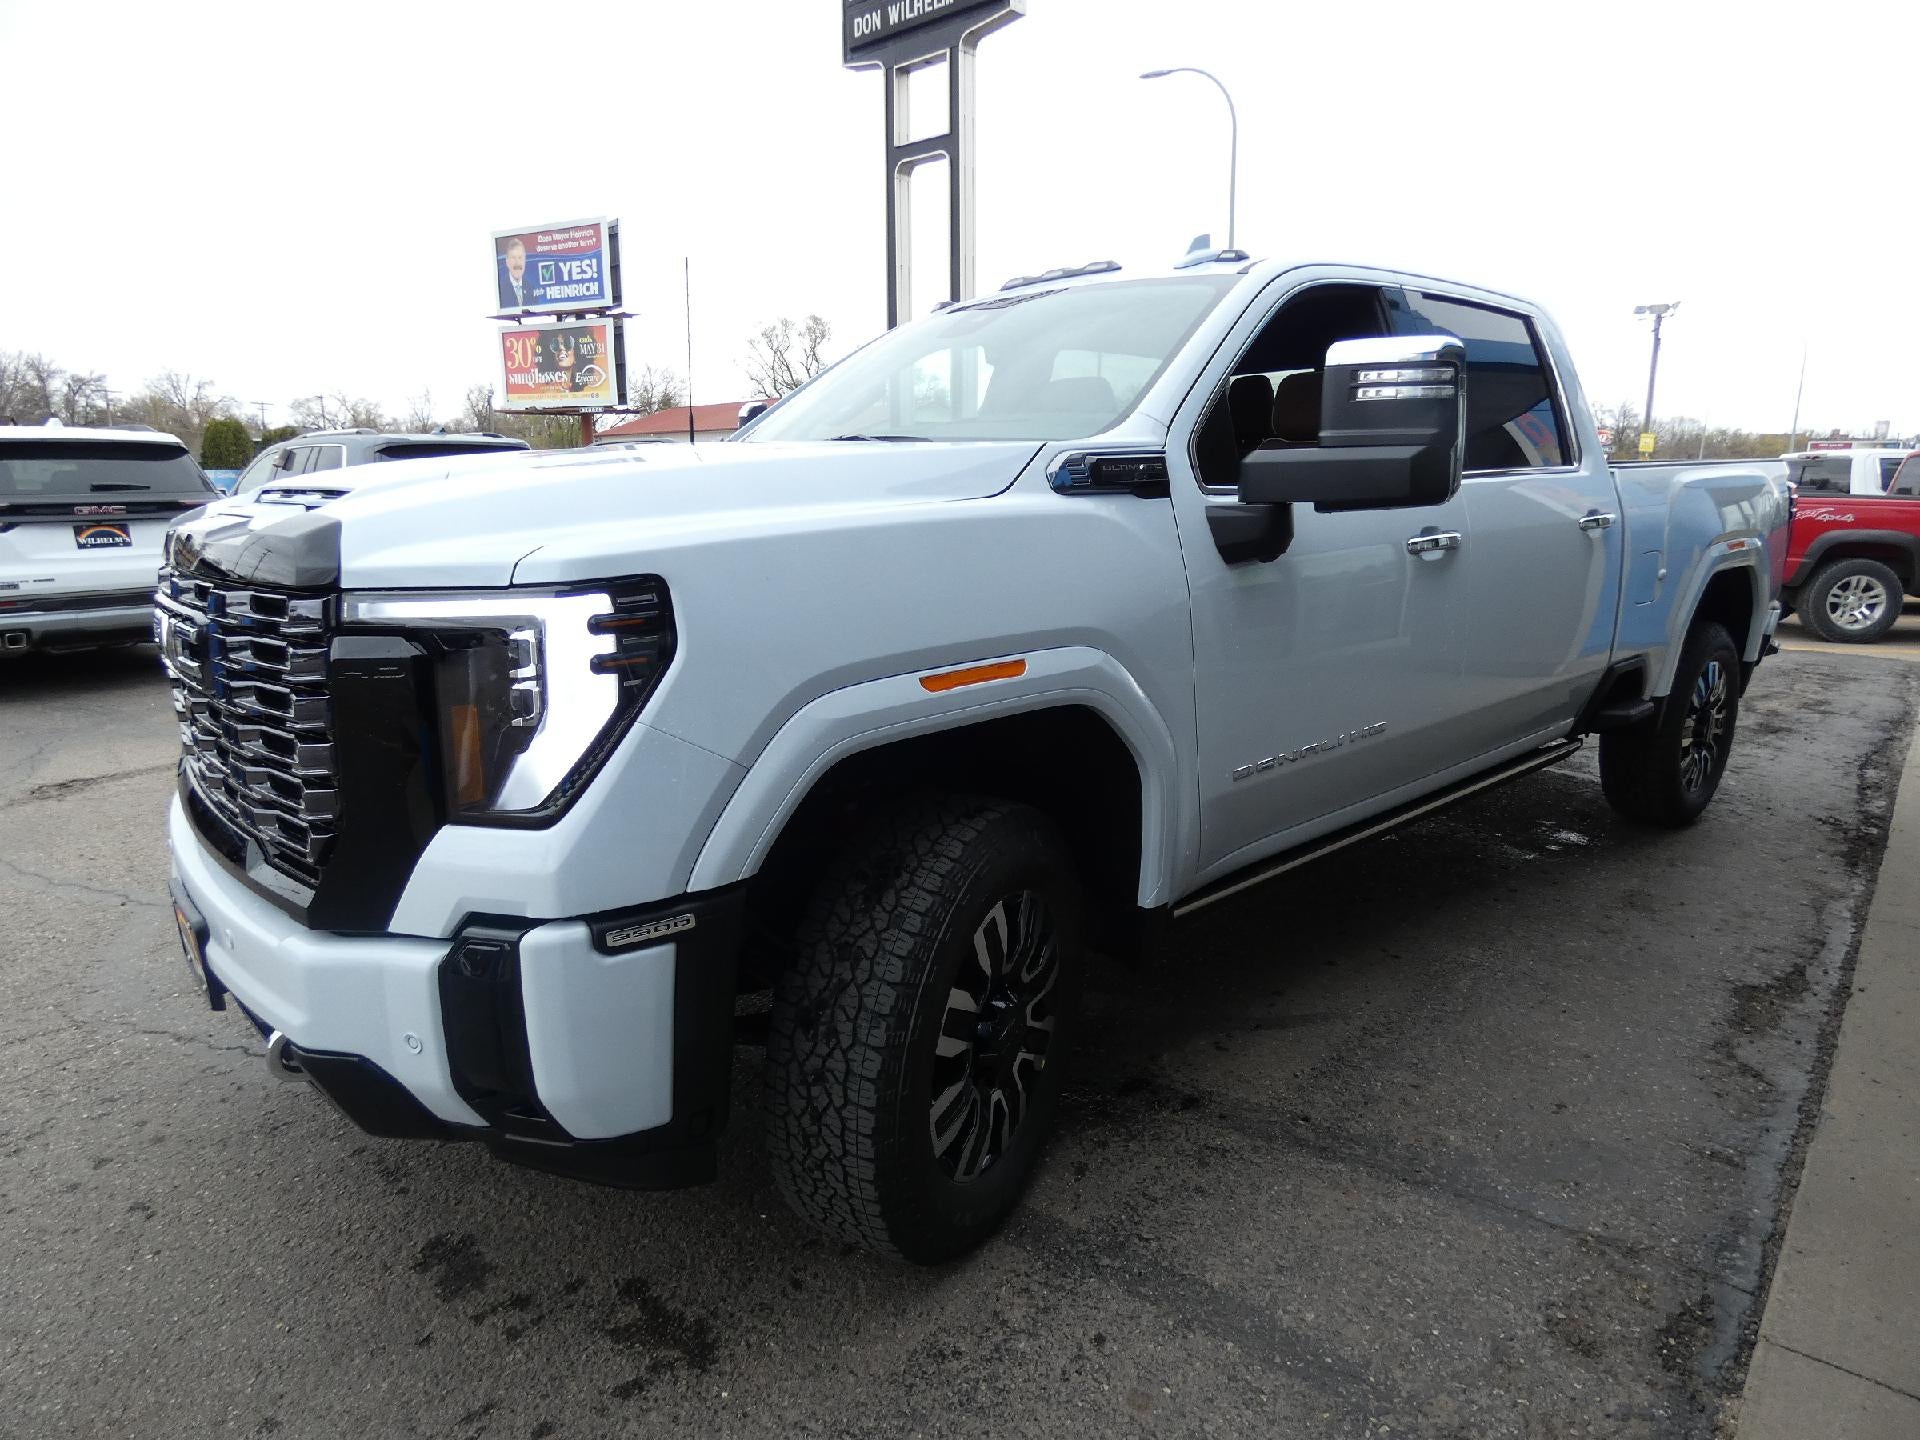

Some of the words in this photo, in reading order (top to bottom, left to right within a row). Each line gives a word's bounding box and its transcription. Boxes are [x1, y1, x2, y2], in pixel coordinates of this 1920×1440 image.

[854, 10, 881, 38] DON
[888, 0, 954, 26] WILHE
[558, 258, 599, 281] YES!
[545, 282, 599, 299] HEINRICH
[580, 343, 596, 355] MAY
[74, 505, 127, 515] GMC
